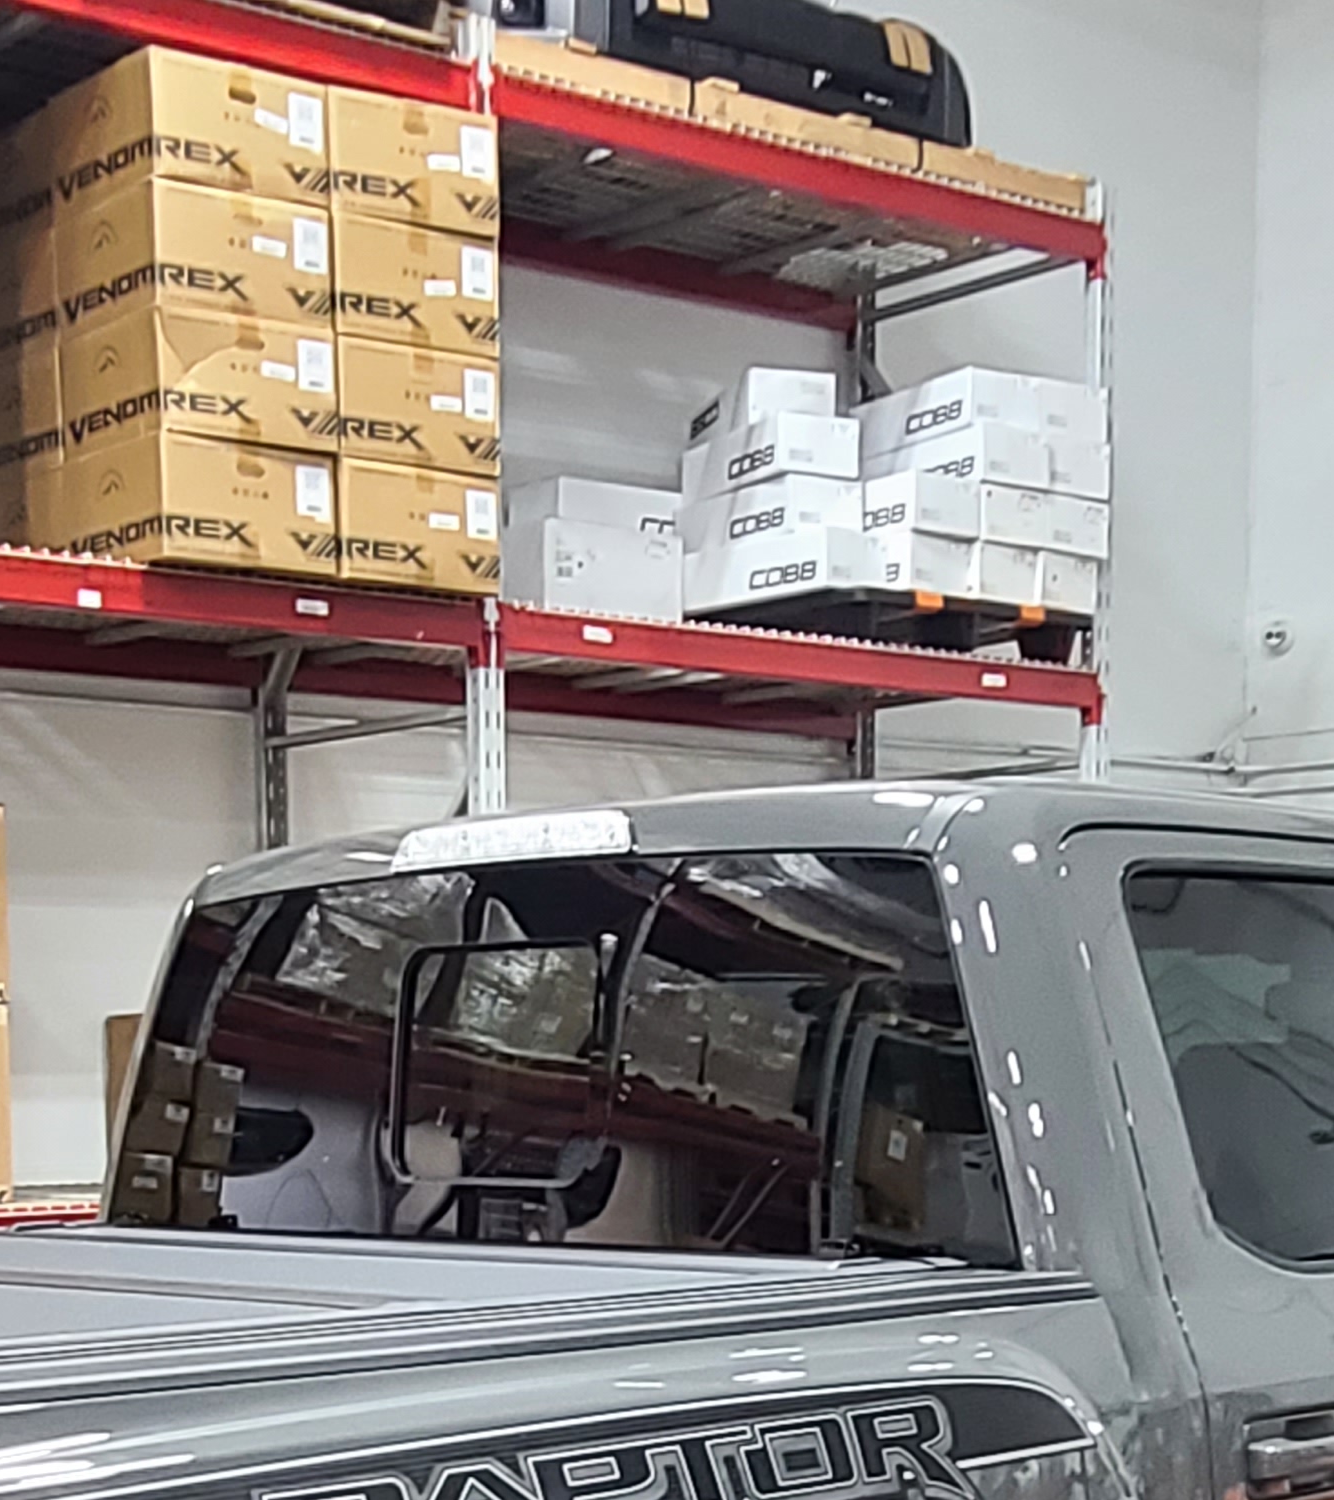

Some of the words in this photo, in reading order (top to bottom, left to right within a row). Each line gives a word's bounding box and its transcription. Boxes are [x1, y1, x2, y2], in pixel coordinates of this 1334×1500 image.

[56, 135, 154, 202] VENOM
[155, 134, 249, 177] REX
[332, 169, 421, 208] REX
[62, 263, 155, 325] VENOM
[157, 262, 250, 302] REX
[339, 291, 424, 329] REX
[69, 388, 162, 446] VENOM
[163, 388, 257, 425] REX
[341, 417, 430, 453] REX
[164, 514, 258, 549] REX
[729, 507, 785, 540] COBB
[863, 503, 906, 533] OBB
[345, 537, 429, 570] REX
[749, 560, 817, 590] COBB
